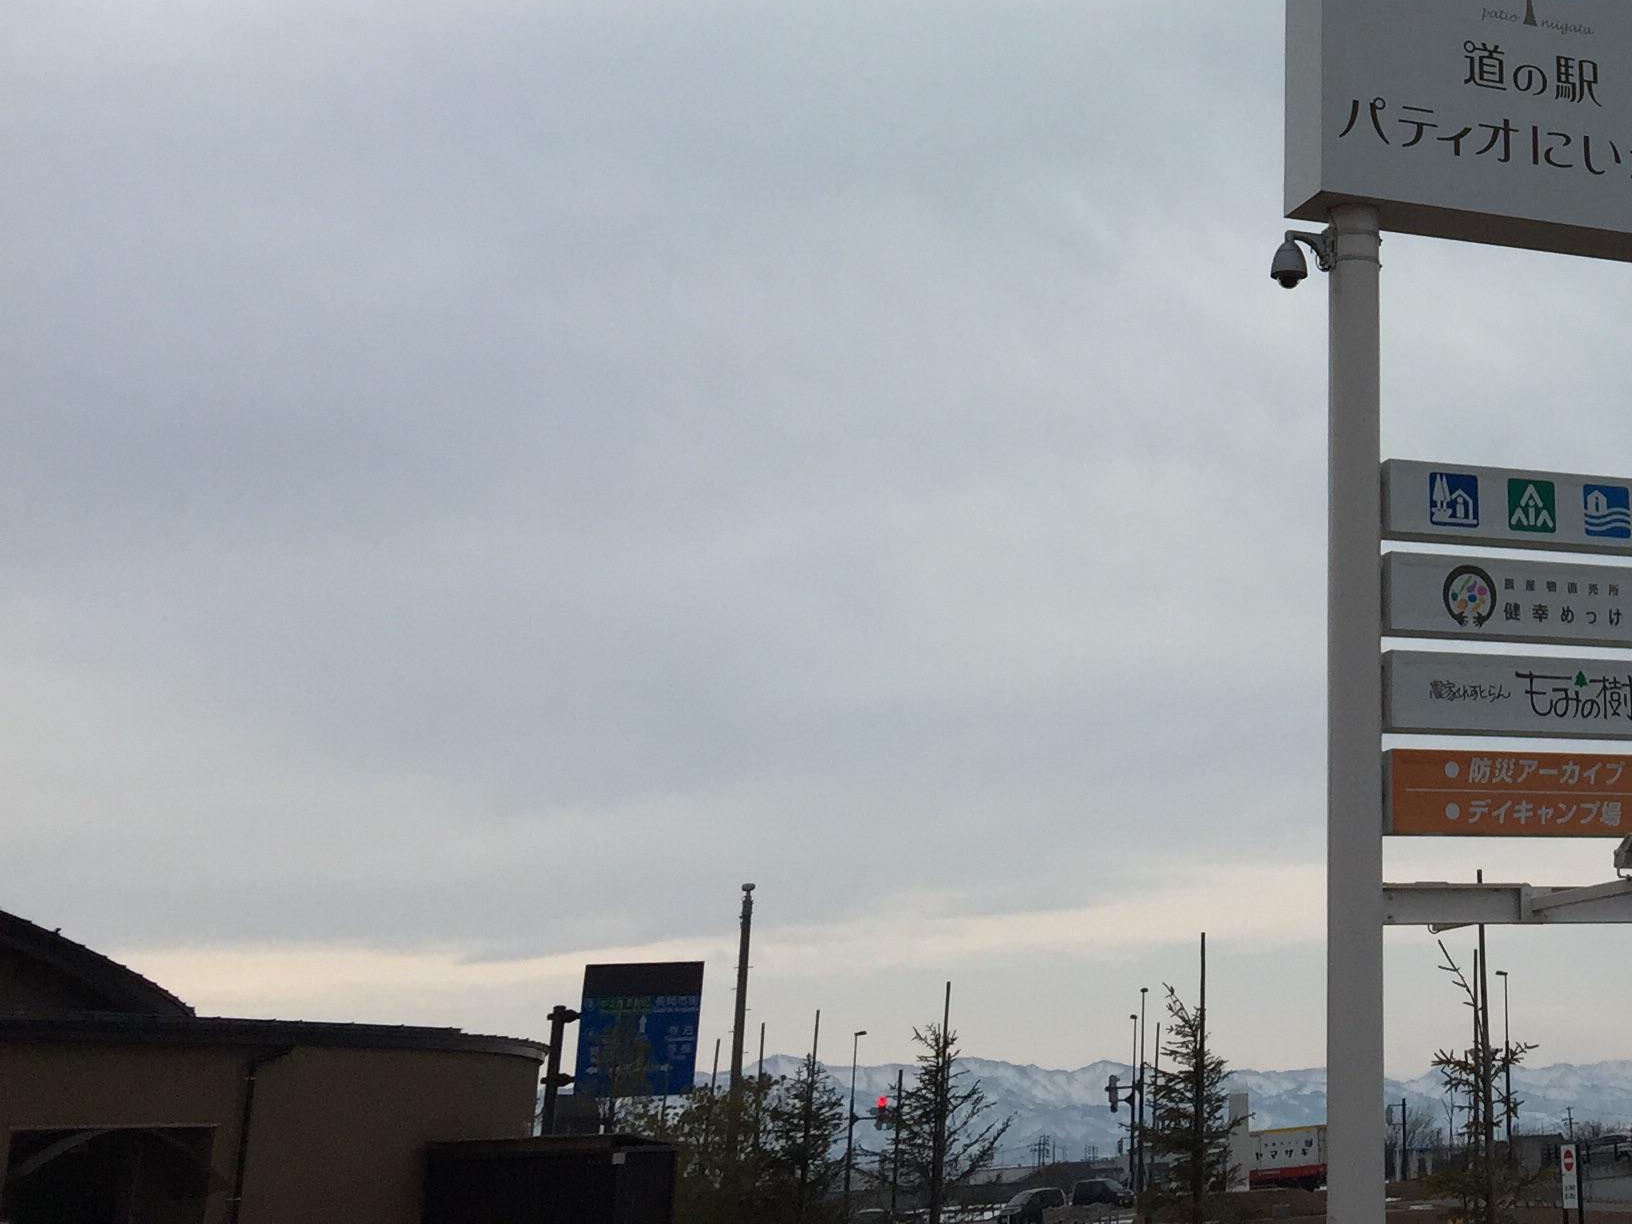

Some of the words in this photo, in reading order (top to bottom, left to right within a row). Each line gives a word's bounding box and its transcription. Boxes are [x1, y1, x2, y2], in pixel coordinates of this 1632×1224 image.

[1463, 40, 1603, 108] 道の駅
[1503, 601, 1622, 626] 健幸めっけ
[1467, 757, 1626, 782] 防災アーカイブ
[1466, 798, 1623, 827] デイキャンプ場
